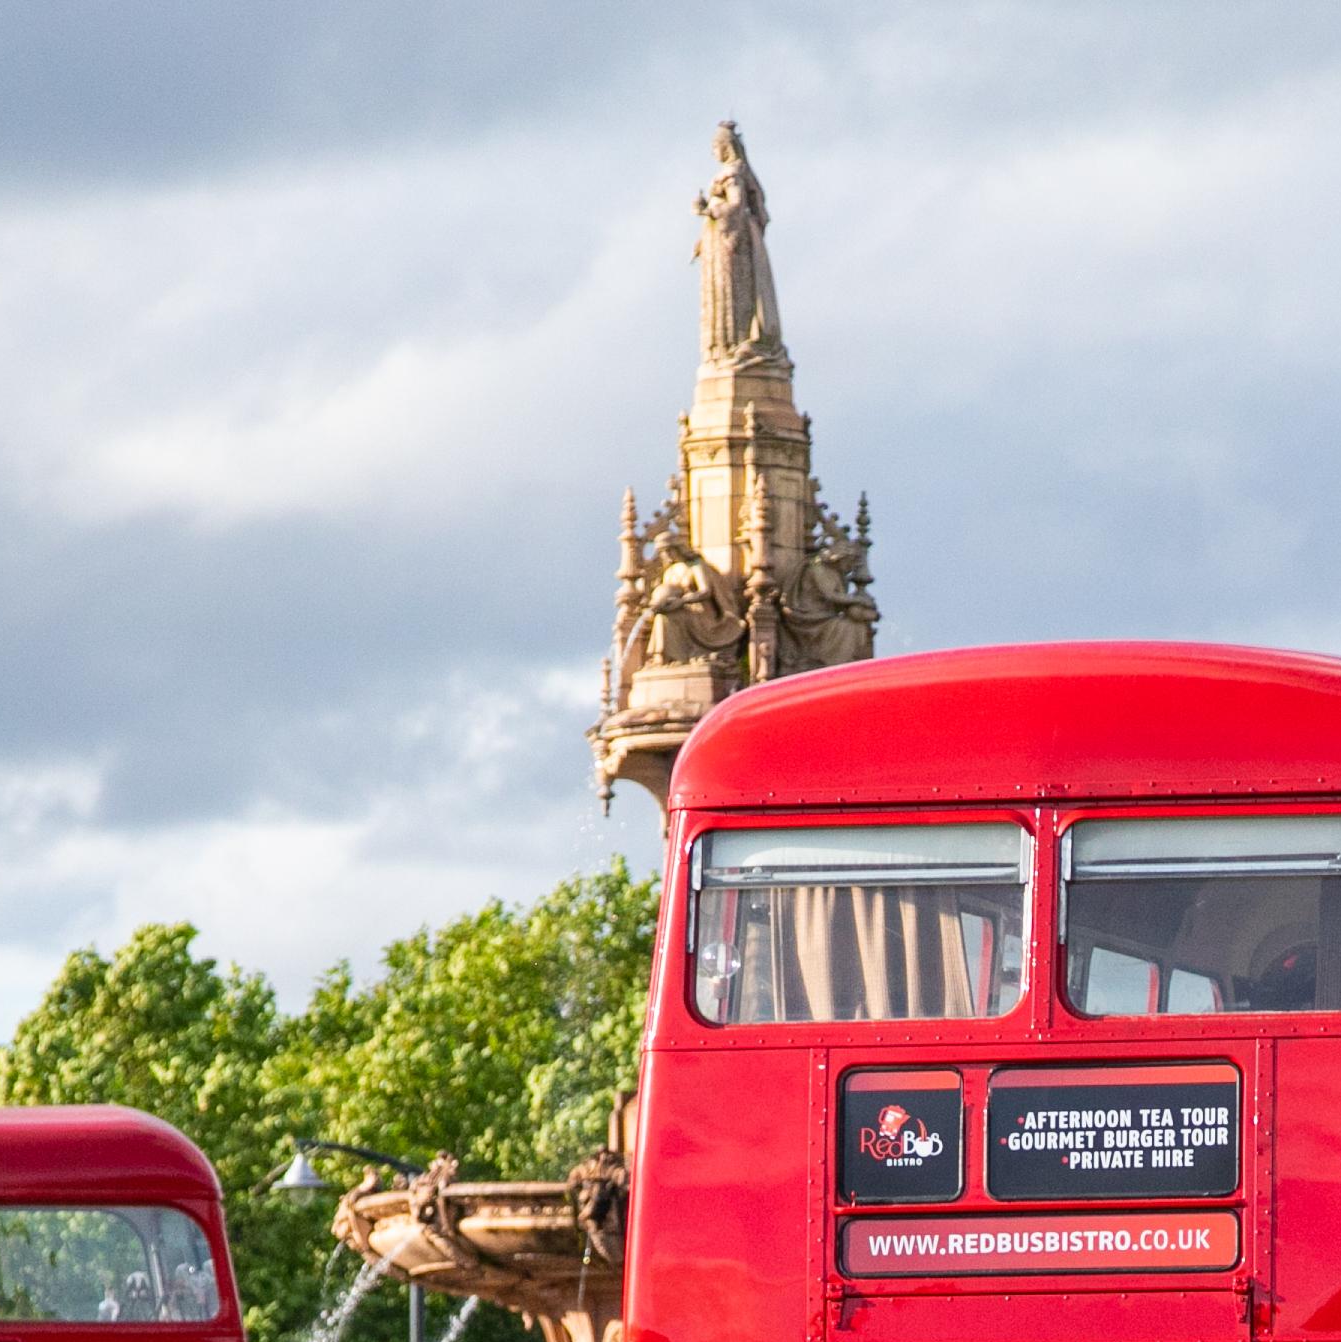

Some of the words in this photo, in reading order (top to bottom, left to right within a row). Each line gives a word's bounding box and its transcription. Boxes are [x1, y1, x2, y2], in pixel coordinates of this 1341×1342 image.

[1024, 1109, 1133, 1131] AFTERNOON
[1139, 1108, 1175, 1129] TEA
[1180, 1107, 1230, 1128] TOUR
[1007, 1131, 1097, 1152] GOURMET
[1104, 1130, 1177, 1150] BURGER
[1180, 1128, 1230, 1148] TOUR
[885, 1157, 924, 1168] BISTRO
[1069, 1150, 1145, 1170] PRIVATE
[1151, 1148, 1196, 1169] HIRE
[867, 1227, 1211, 1257] WWW.REDBUSBISTRO.CO.UK
